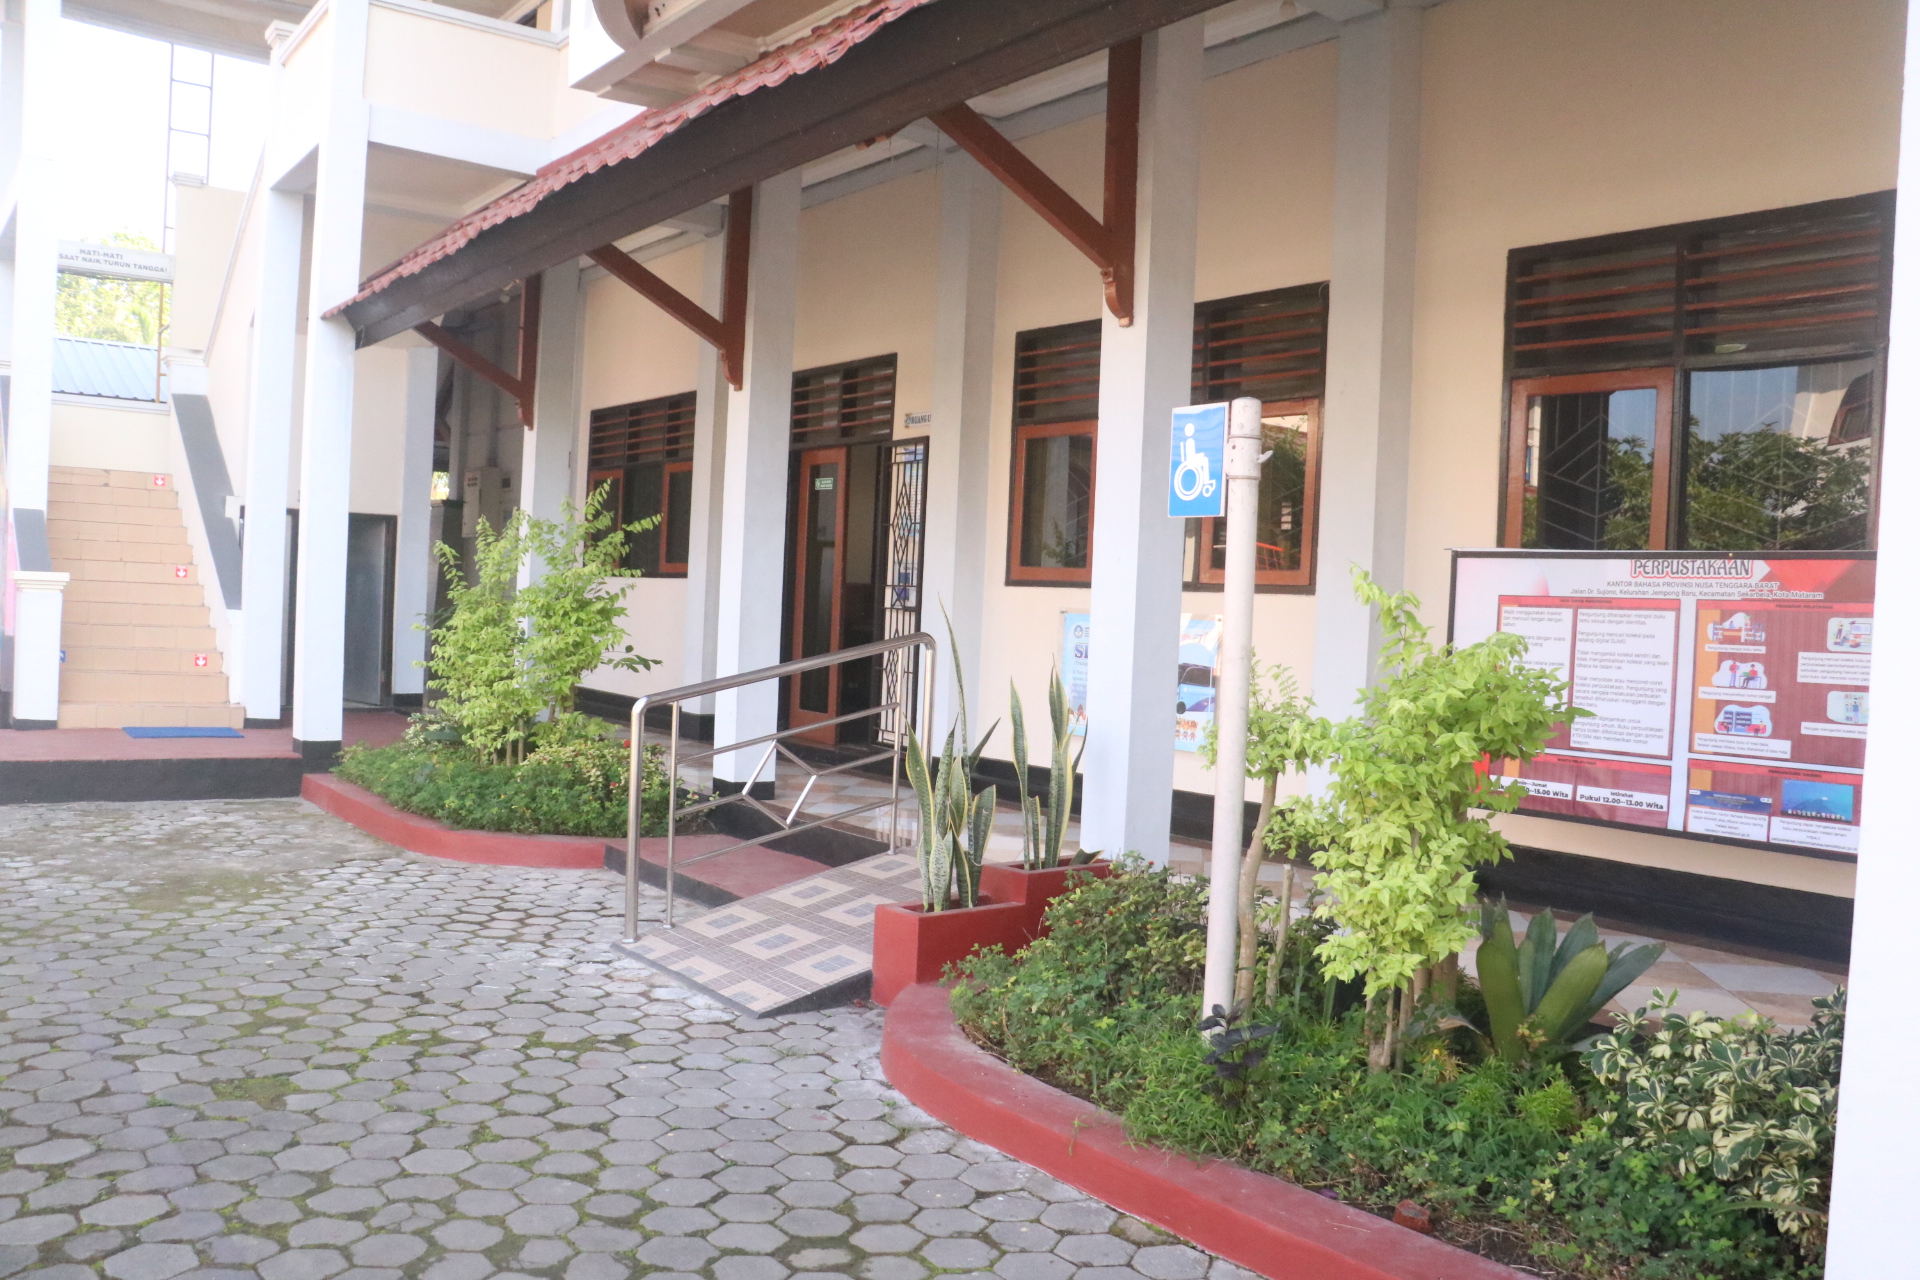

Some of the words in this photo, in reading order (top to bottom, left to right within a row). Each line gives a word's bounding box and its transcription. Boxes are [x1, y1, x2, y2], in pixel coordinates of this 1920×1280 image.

[80, 248, 123, 260] HATI-HATI
[133, 263, 168, 273] TANGGA!
[1633, 560, 1751, 577] PERPUSTAKAAN
[1650, 590, 1680, 598] Jempong
[1682, 590, 1697, 598] Baru,
[1737, 591, 1772, 600] Sekarbela,
[1630, 725, 1664, 733] perpustakaan
[1552, 790, 1568, 798] Wita
[1580, 794, 1600, 802] Pukul
[1645, 801, 1664, 810] Wita
